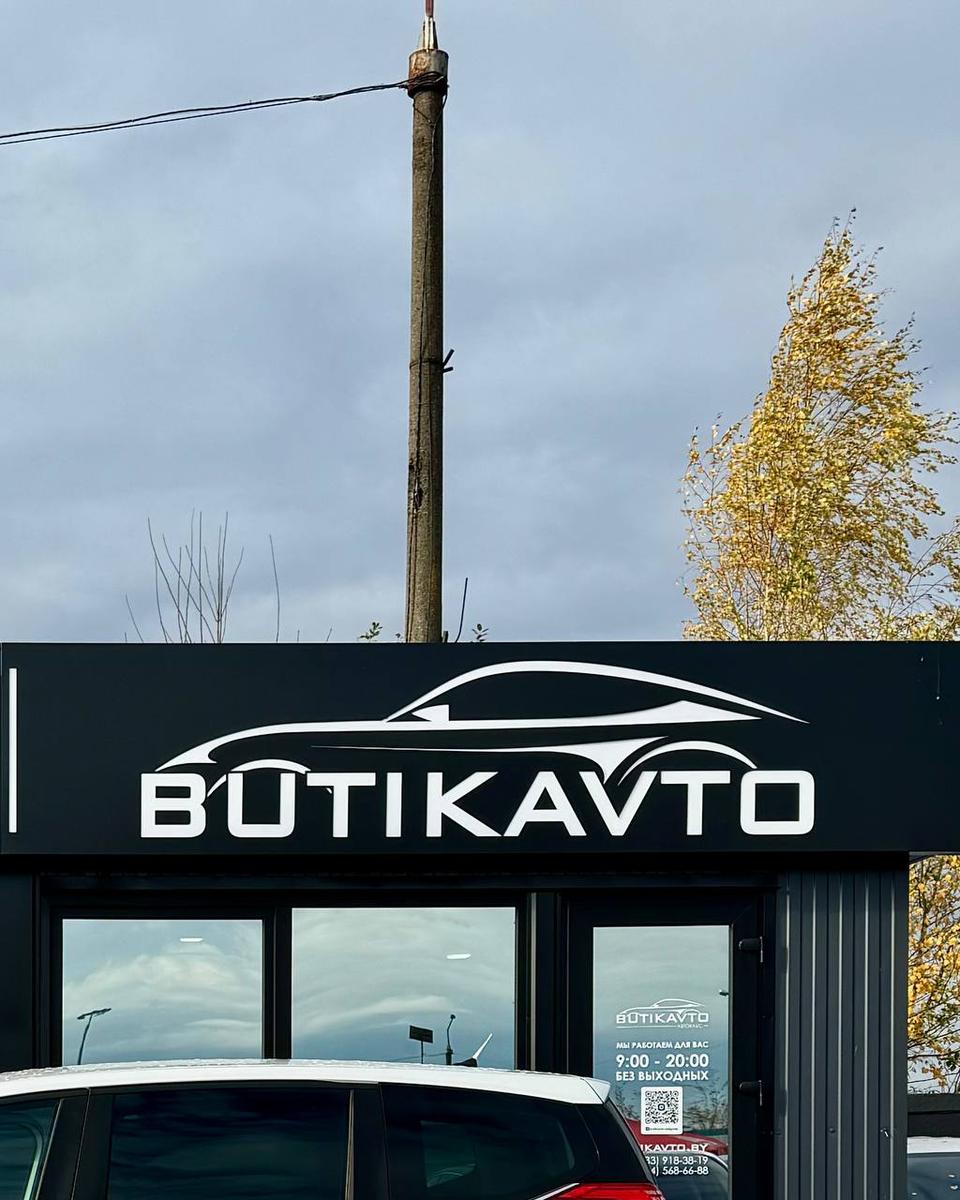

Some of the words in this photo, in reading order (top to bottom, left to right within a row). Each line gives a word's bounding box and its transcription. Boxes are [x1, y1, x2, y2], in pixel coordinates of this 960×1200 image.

[140, 769, 815, 839] BUTIKAVTO
[616, 1012, 709, 1024] BUTIKAVTO
[631, 1041, 673, 1049] РАБОТАЕМ
[674, 1041, 691, 1049] ДЛЯ
[615, 1054, 650, 1068] 9:00
[665, 1053, 709, 1068] 20:00
[615, 1071, 635, 1081] БЕЗ
[638, 1070, 709, 1082] ВЫХОДНЫХ
[640, 1143, 709, 1152] IKAVTO.BY
[646, 1156, 659, 1167] 33)
[662, 1156, 709, 1165] 918-38-19
[662, 1166, 709, 1175] 568-66-88
